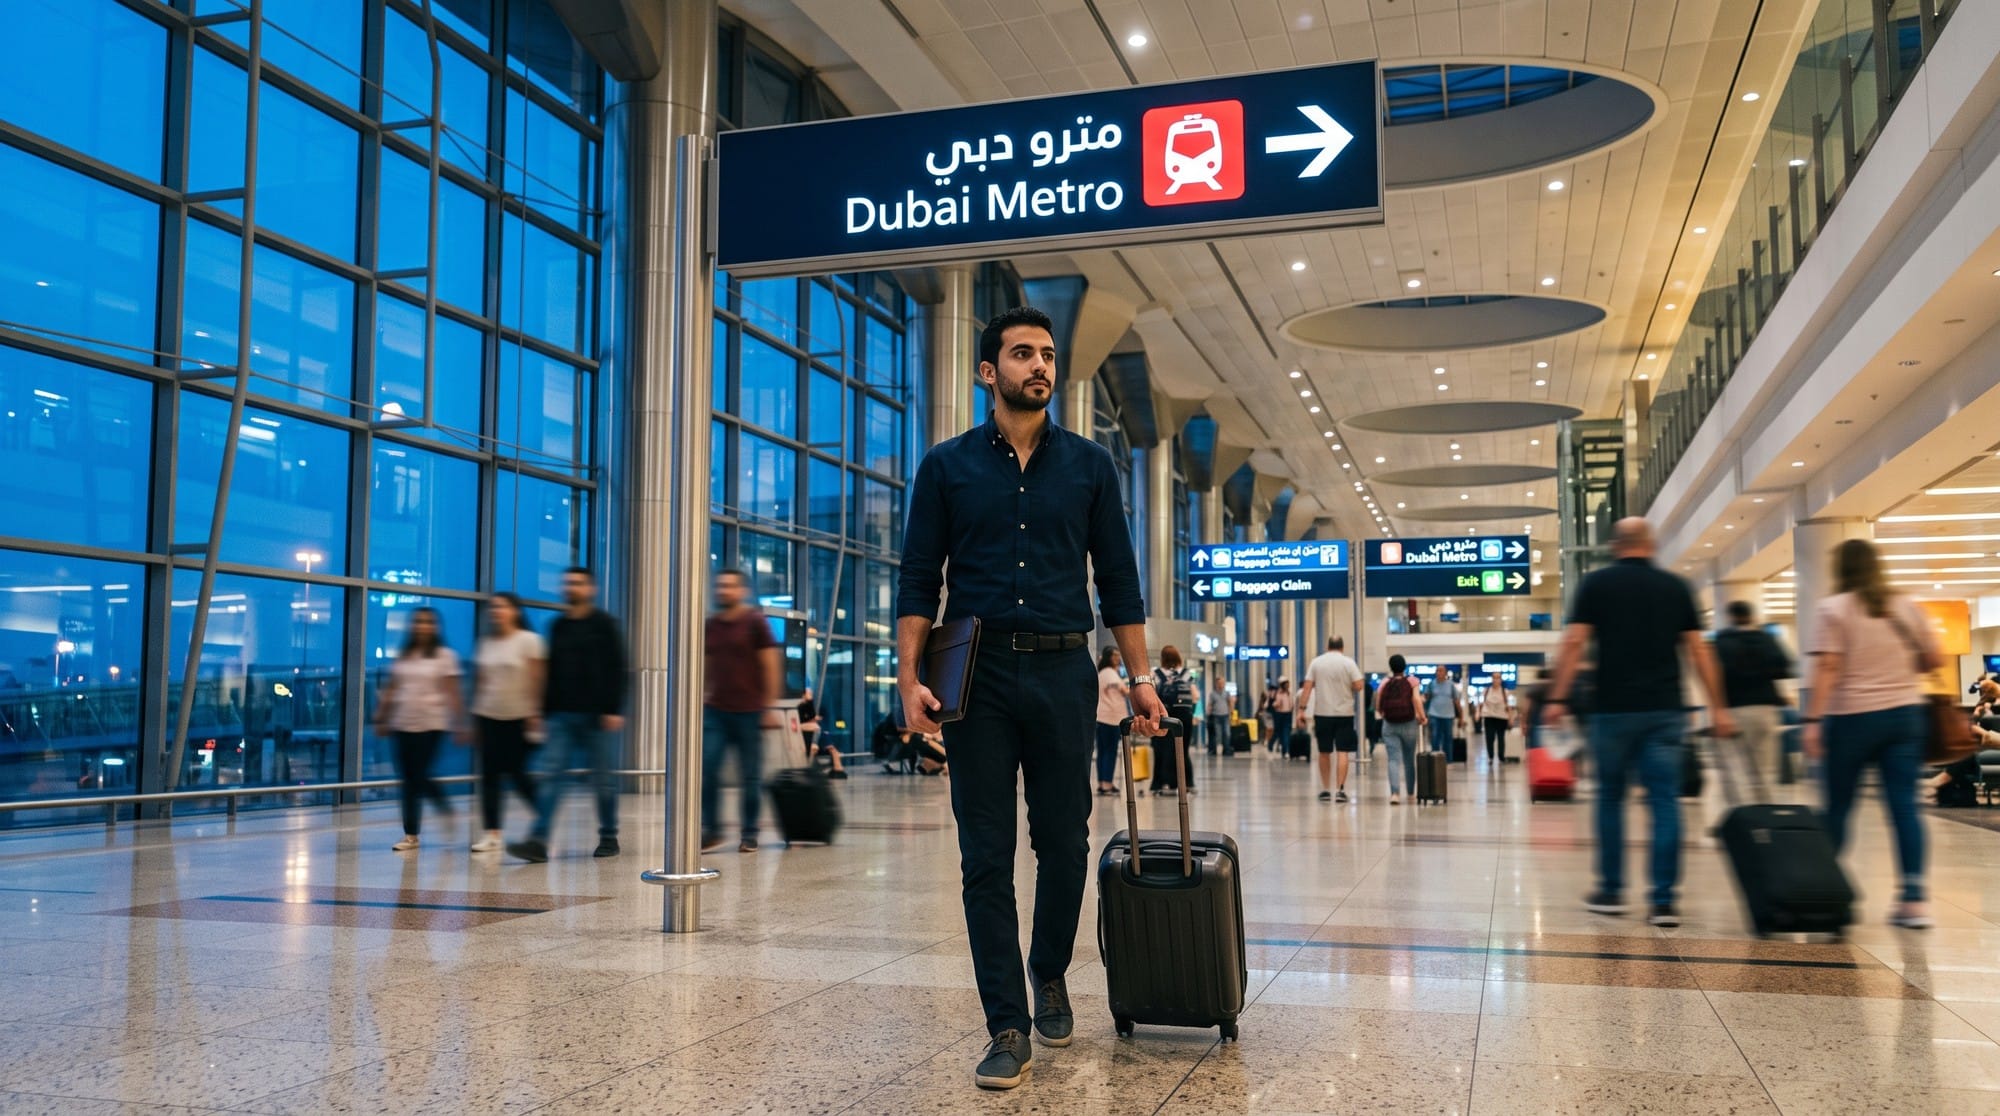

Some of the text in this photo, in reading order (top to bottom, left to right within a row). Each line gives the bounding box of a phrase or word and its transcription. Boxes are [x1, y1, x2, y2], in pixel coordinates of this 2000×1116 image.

[925, 115, 1122, 186] مترو دبي
[846, 179, 1123, 234] Dubai Metro
[1406, 552, 1477, 563] Dubai Metro
[1234, 579, 1312, 594] Baggage Claim
[1457, 576, 1479, 587] Exit
